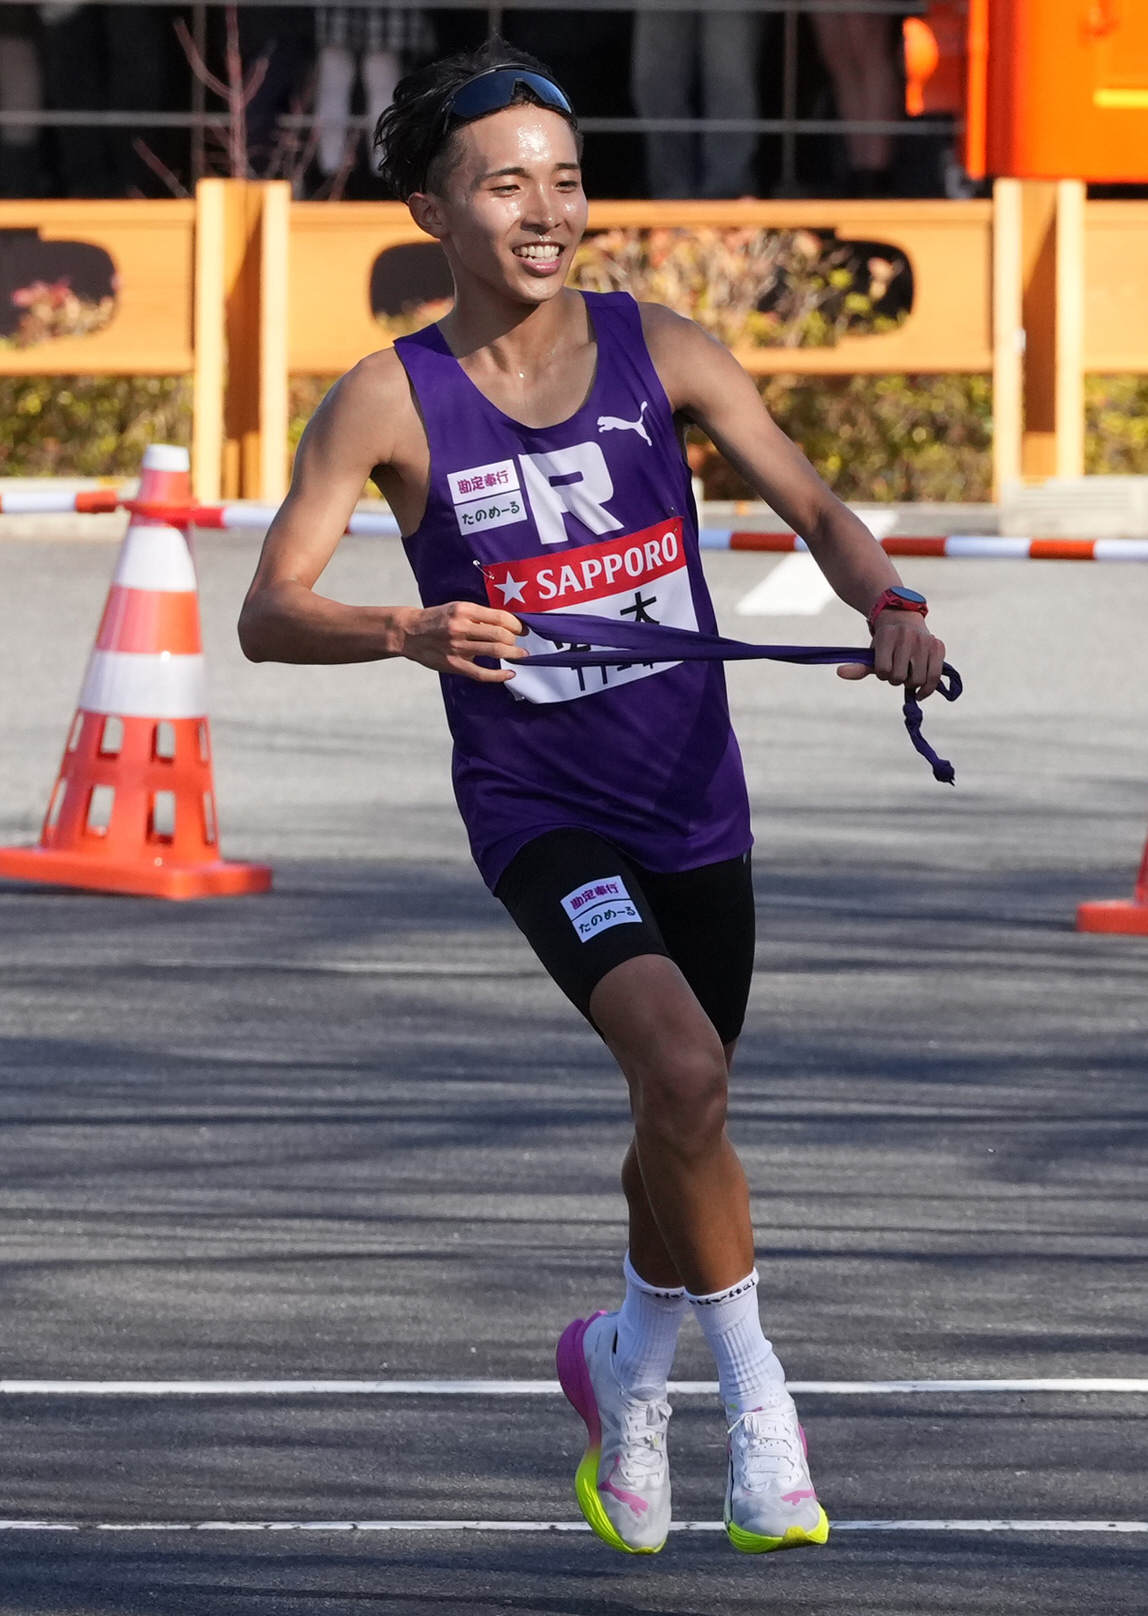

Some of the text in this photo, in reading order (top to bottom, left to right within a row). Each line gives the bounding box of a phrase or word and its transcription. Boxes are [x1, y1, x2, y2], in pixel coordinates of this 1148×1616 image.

[457, 470, 509, 494] 勘定奉行
[517, 441, 625, 545] R
[462, 501, 520, 526] たのめーる
[536, 531, 678, 600] SAPPORO
[570, 883, 619, 910] 勘定奉行
[579, 906, 636, 934] たのめーる
